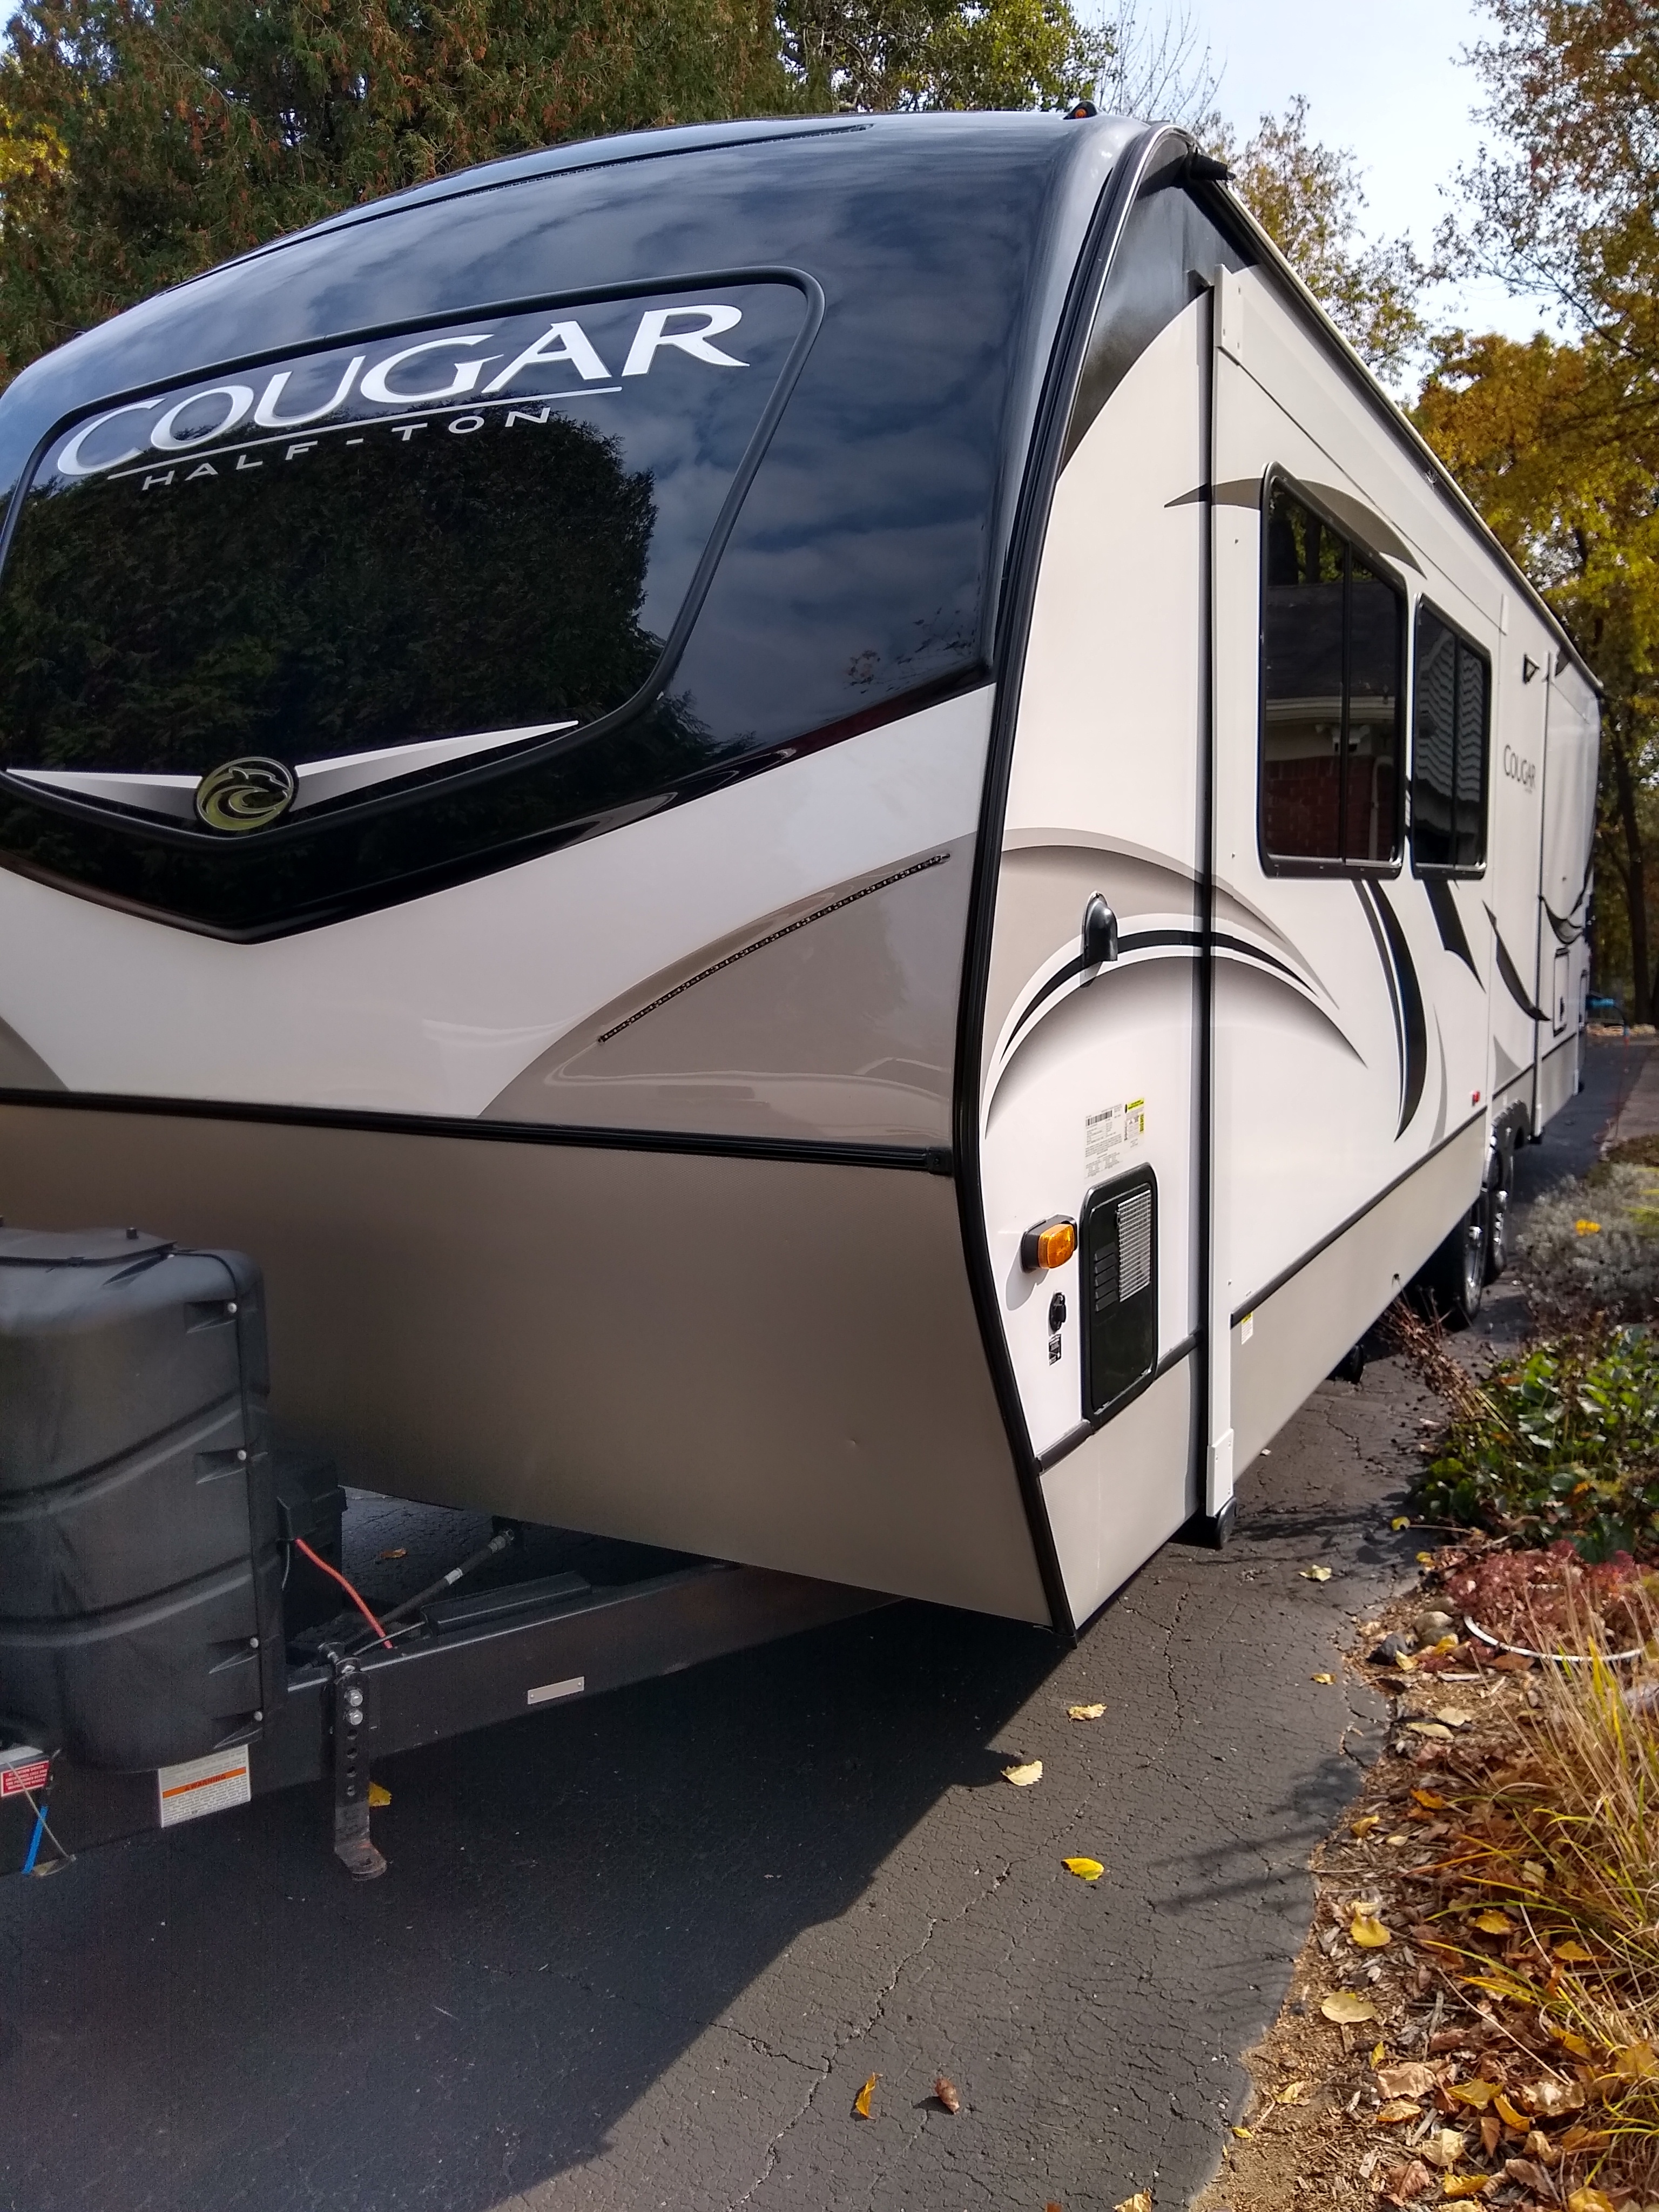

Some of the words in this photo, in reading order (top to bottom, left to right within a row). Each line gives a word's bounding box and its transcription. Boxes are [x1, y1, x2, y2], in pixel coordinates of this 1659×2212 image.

[58, 304, 750, 476] COUGAR
[141, 407, 551, 490] HALF-TON
[1503, 744, 1536, 788] COUGAR
[191, 1774, 226, 1789] WARNING
